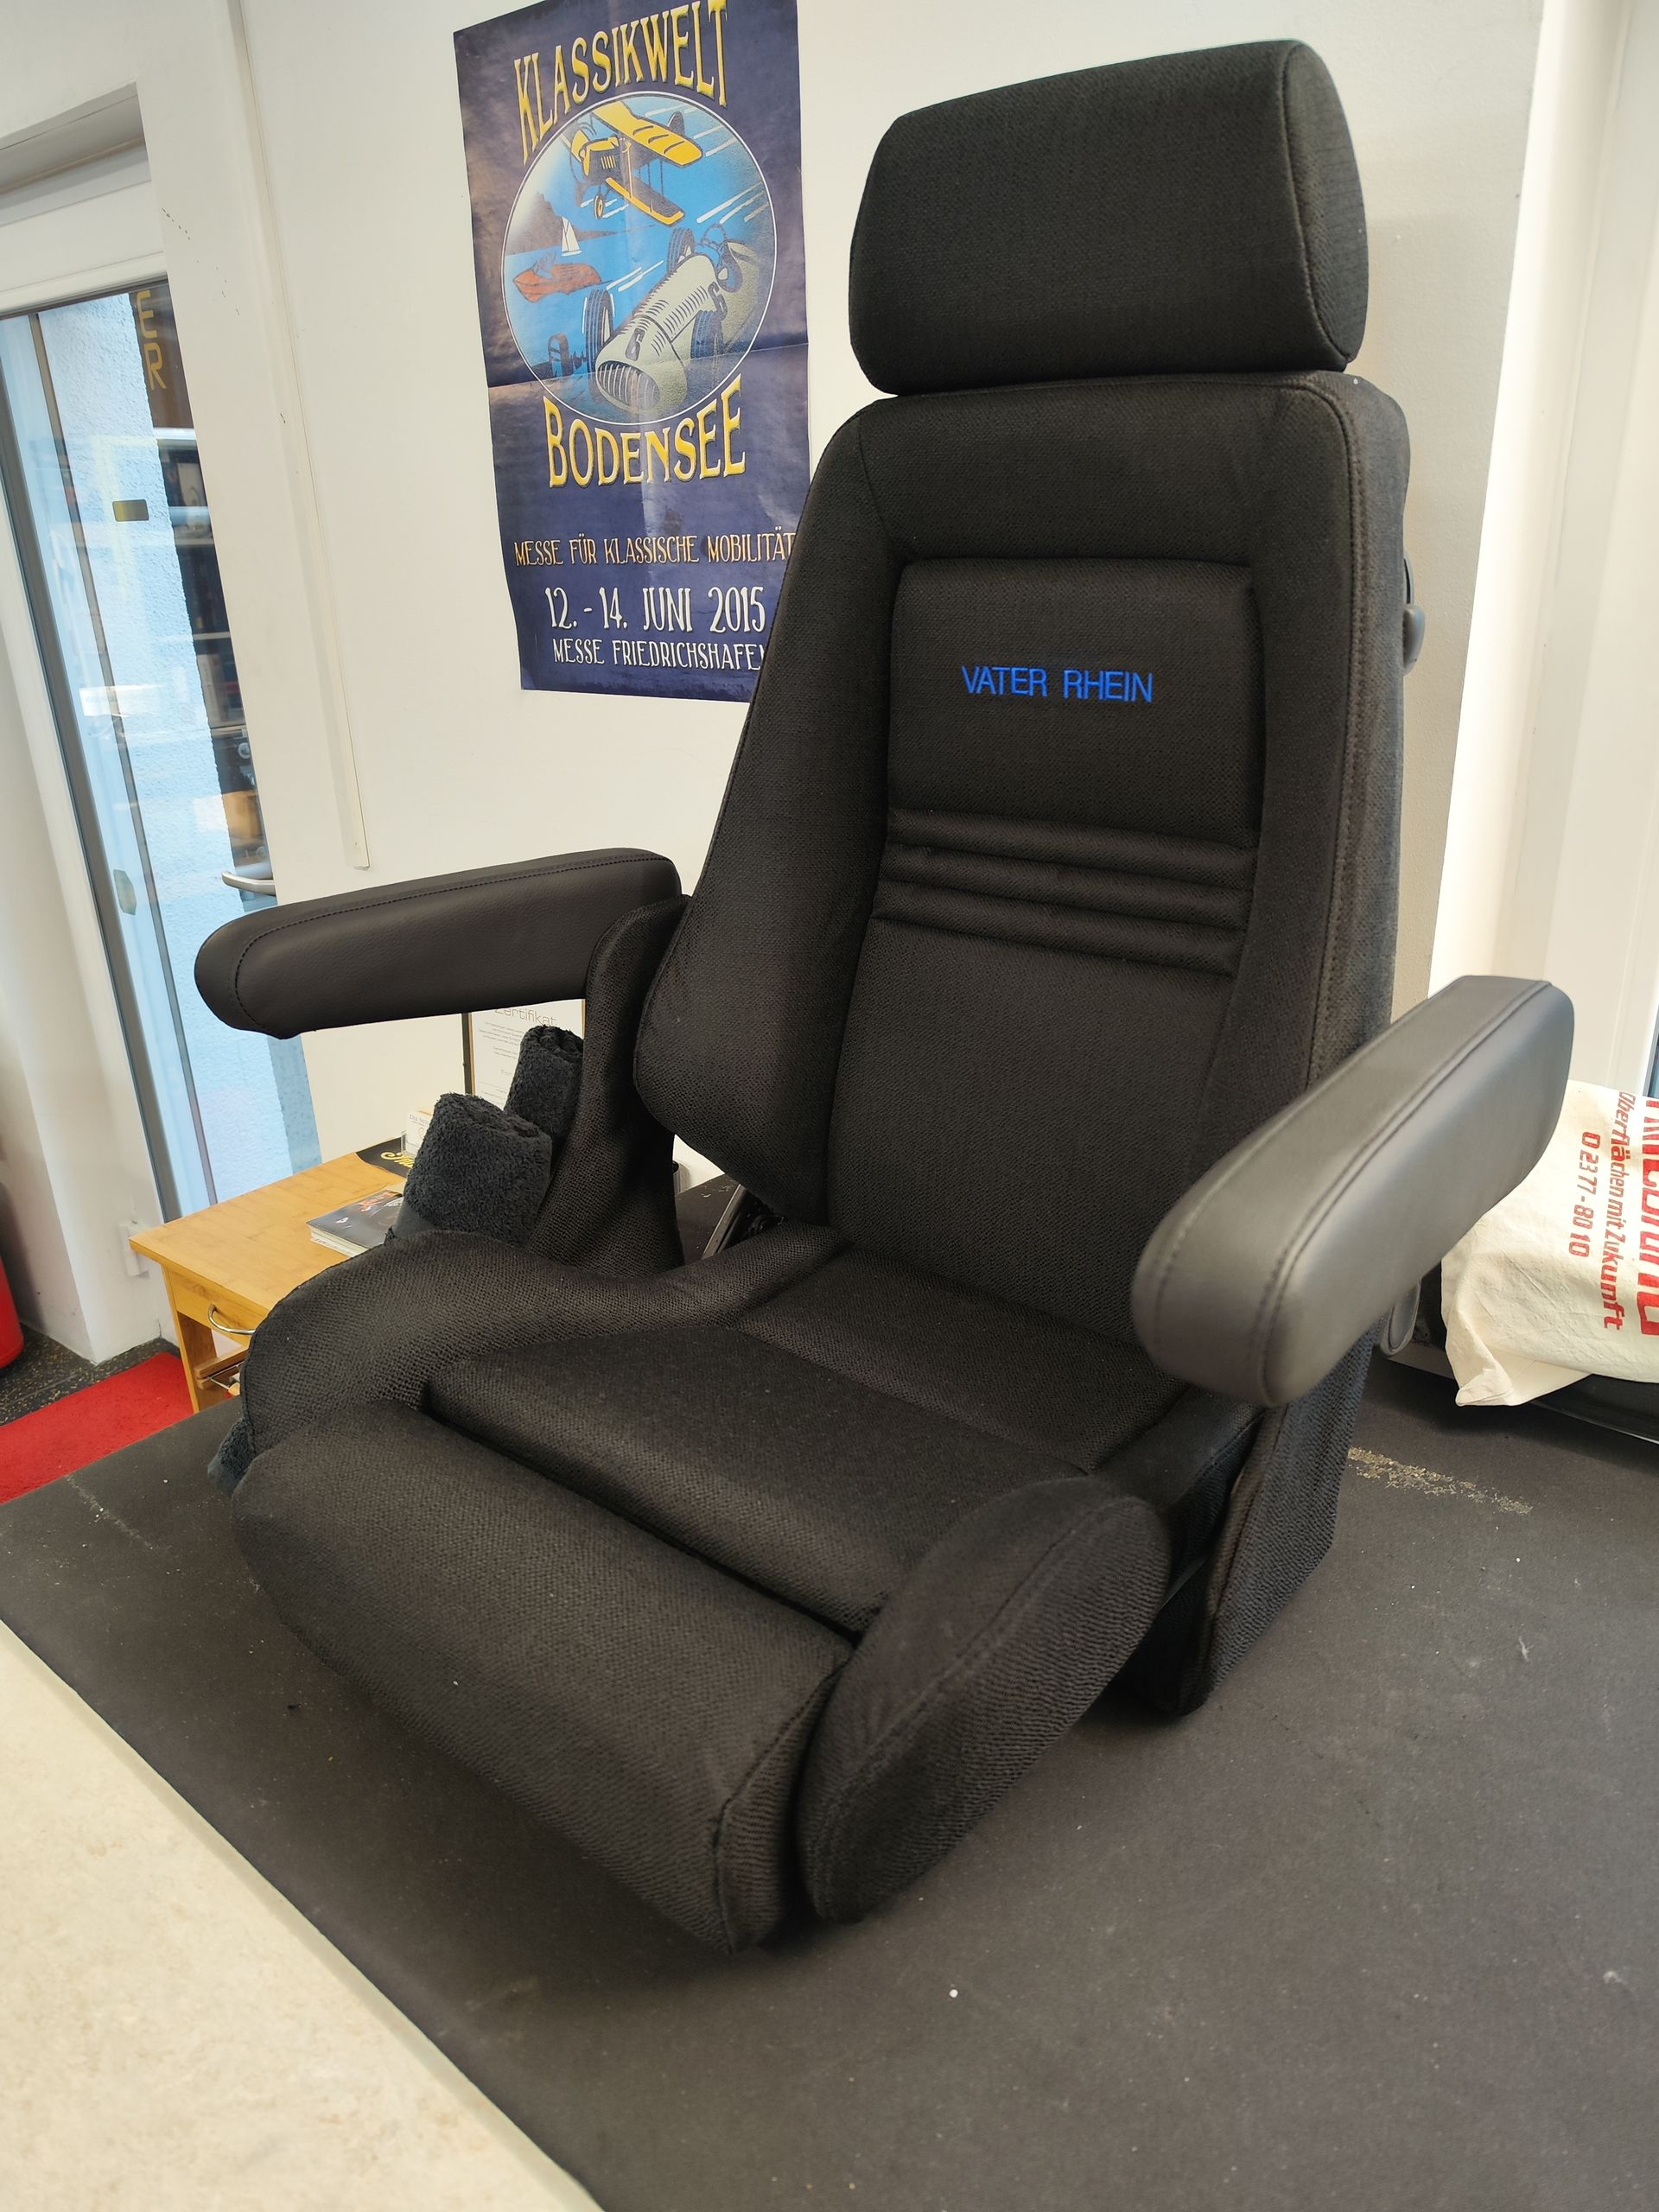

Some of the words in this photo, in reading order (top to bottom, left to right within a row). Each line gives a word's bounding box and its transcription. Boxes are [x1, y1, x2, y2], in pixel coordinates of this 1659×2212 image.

[513, 0, 729, 166] KLASSIKWELT
[543, 373, 746, 488] BODENSEE
[513, 540, 564, 566] MESSE
[569, 533, 597, 565] FÜR
[603, 535, 700, 566] KLASSISCHE
[707, 525, 797, 563] MOBILITÄT
[544, 587, 578, 630] 12.
[599, 587, 628, 630] 14.
[642, 587, 694, 632] JUNI
[707, 586, 766, 633] 2015
[552, 638, 605, 664] MESSE
[961, 664, 1048, 698] VATER
[1063, 668, 1154, 703] RHEIN
[1608, 1091, 1637, 1198] Oberflächen
[1605, 1200, 1627, 1230] mit
[1599, 1230, 1626, 1330] Zukunft
